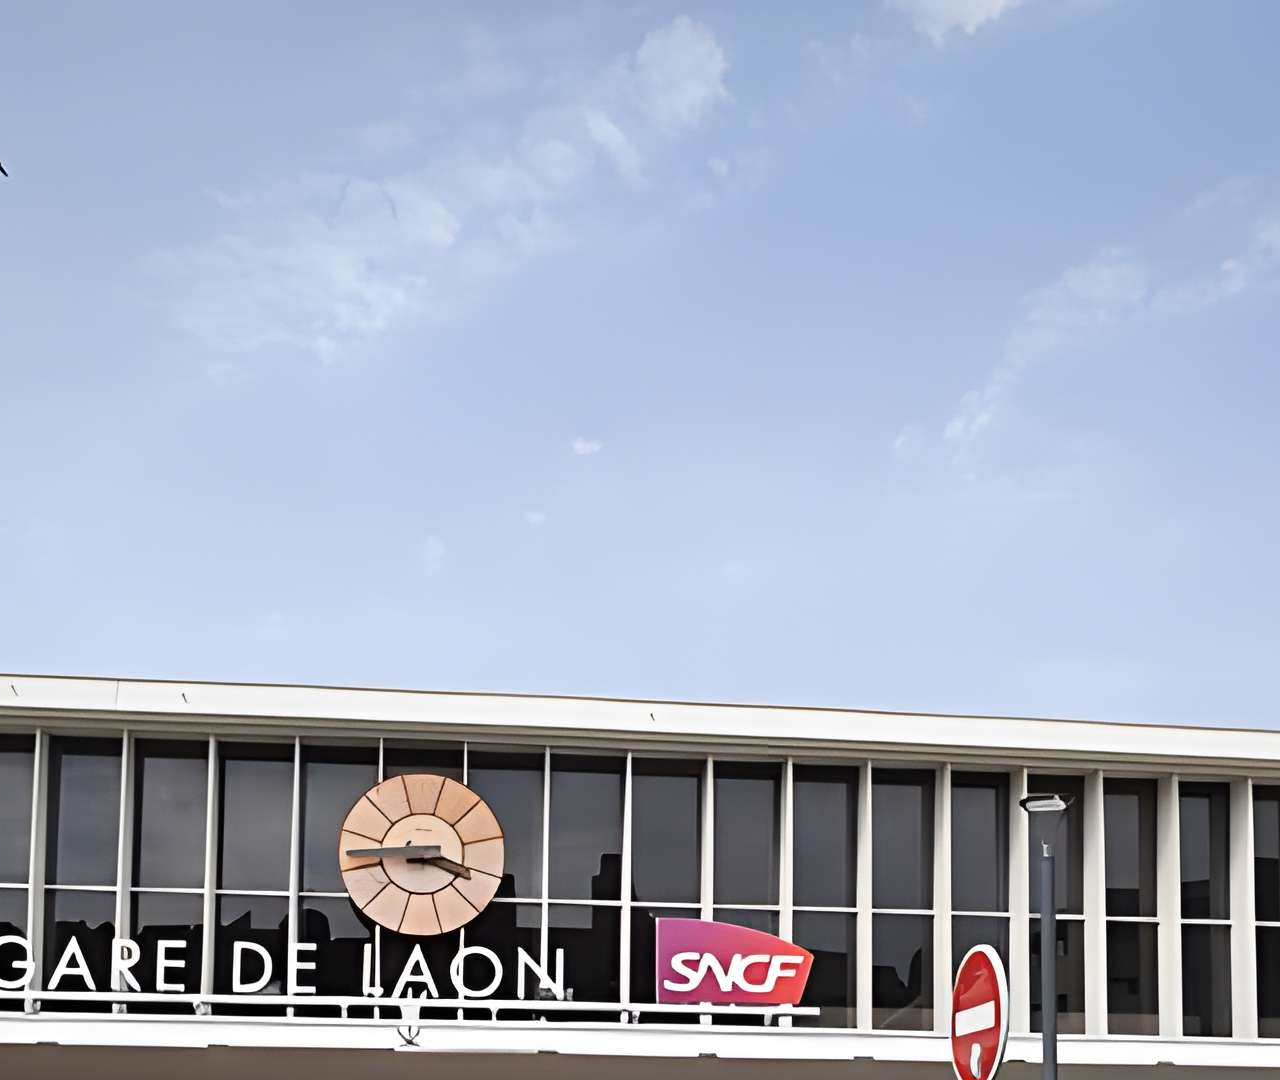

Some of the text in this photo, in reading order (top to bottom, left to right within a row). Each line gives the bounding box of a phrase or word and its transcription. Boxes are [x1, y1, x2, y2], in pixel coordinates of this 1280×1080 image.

[232, 941, 318, 995] DE
[363, 943, 565, 1000] LAON
[663, 952, 805, 993] SNCF
